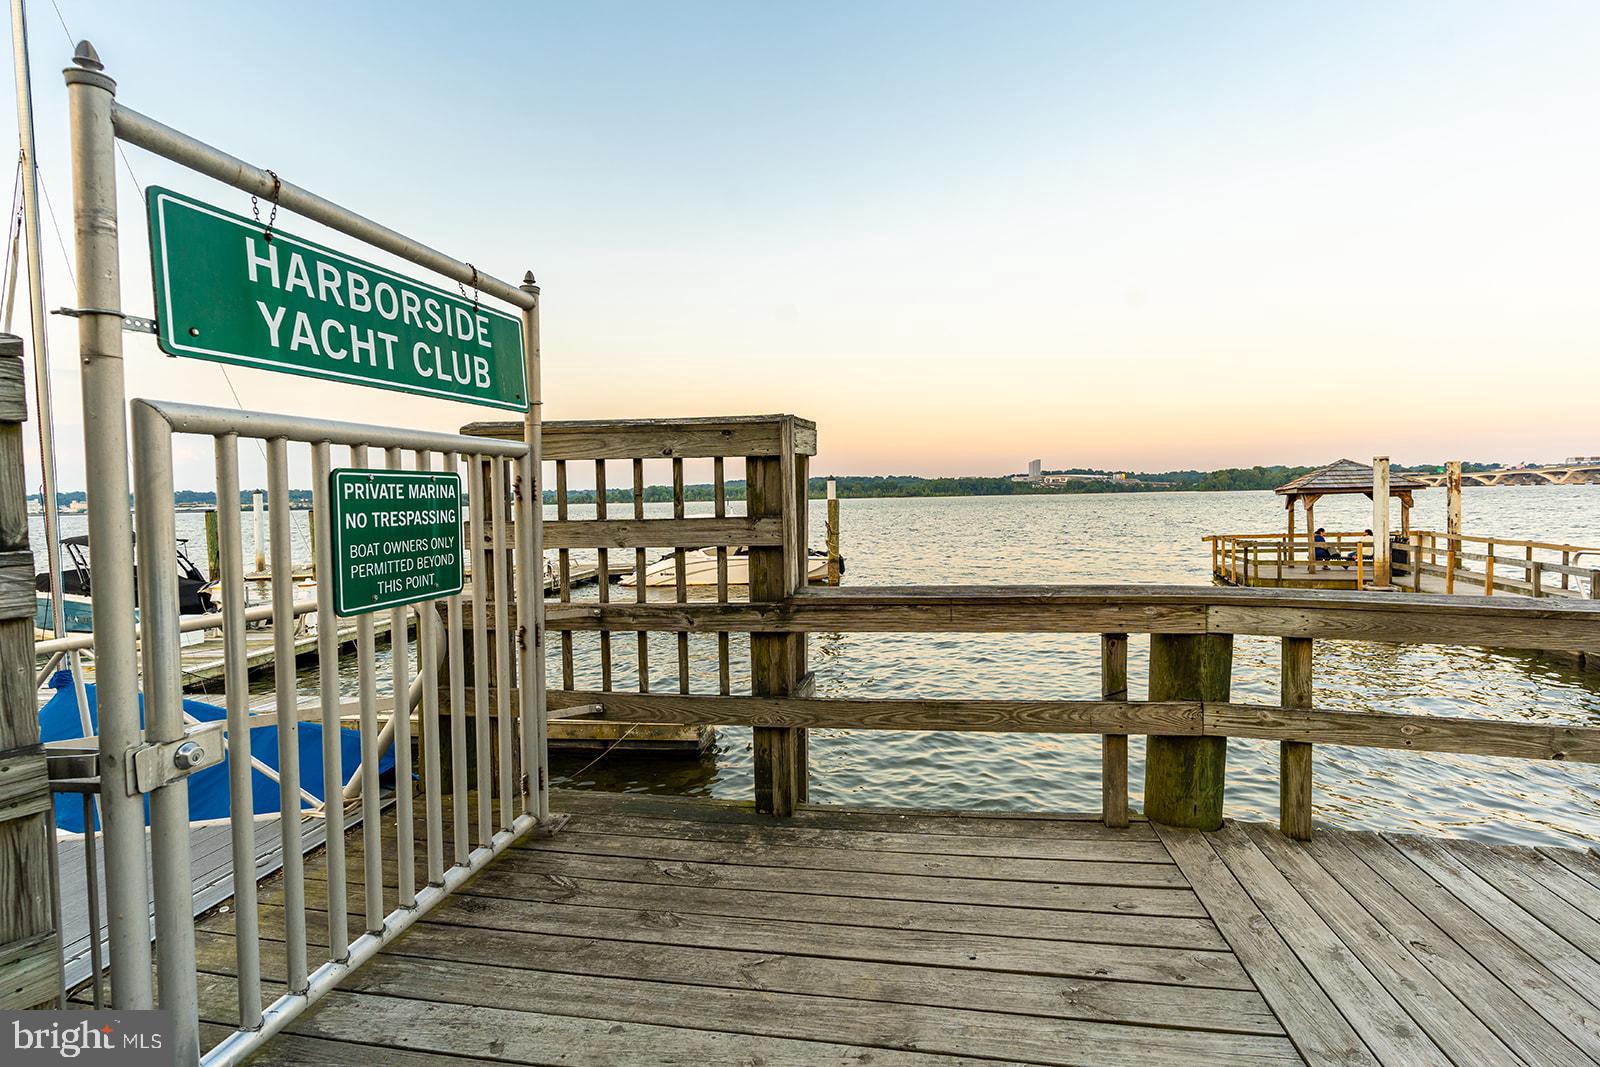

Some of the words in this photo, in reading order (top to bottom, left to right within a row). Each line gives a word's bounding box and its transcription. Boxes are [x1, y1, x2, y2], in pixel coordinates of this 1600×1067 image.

[246, 237, 492, 348] HARBORSIDE
[256, 300, 399, 370] YACHT
[412, 342, 491, 389] CLUB
[344, 483, 404, 499] PRIVATE
[408, 484, 456, 499] MARINA
[345, 512, 367, 529] NO
[372, 509, 456, 528] TRESPASSING
[350, 542, 380, 559] BOAT
[383, 539, 428, 555] OWNERS
[430, 536, 455, 550] ONLY
[351, 558, 414, 579] PERMITTED
[417, 553, 455, 570] BEYOND
[377, 579, 402, 594] THIS
[406, 573, 435, 590] POINT
